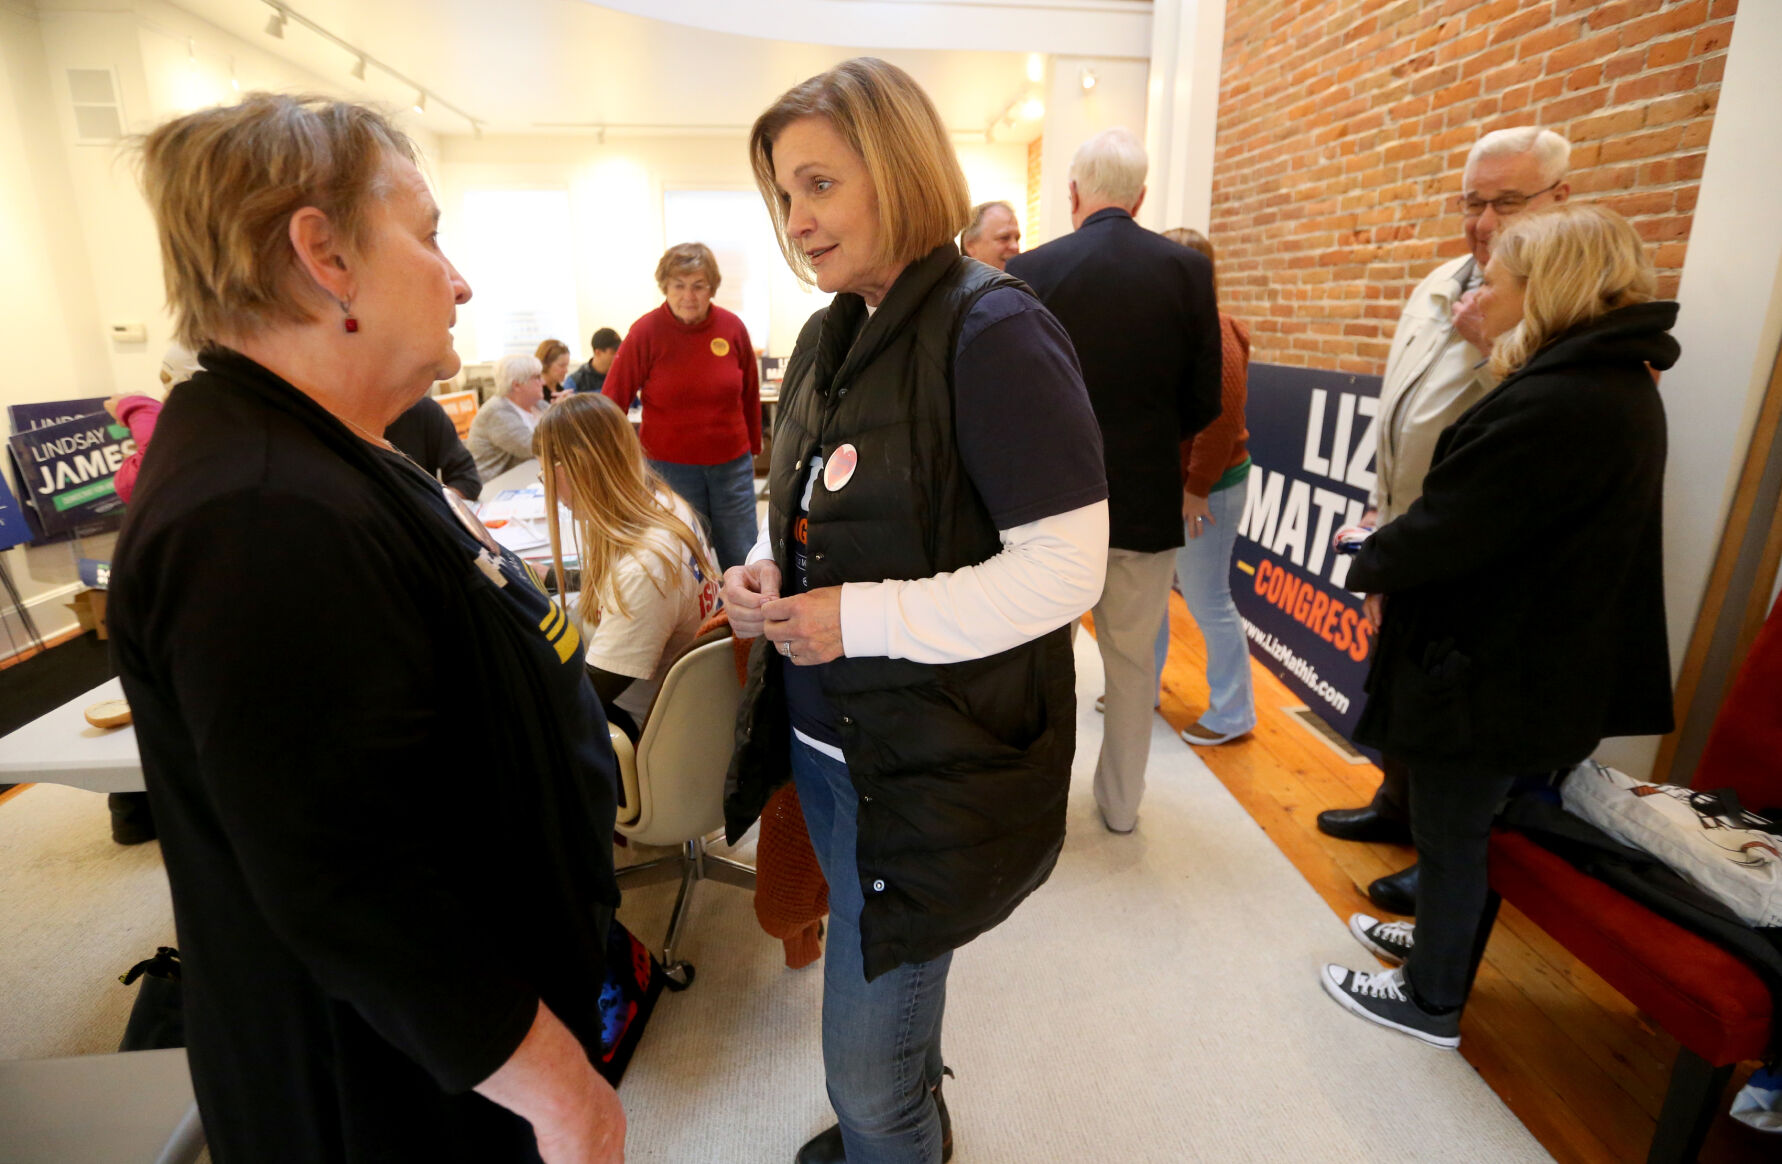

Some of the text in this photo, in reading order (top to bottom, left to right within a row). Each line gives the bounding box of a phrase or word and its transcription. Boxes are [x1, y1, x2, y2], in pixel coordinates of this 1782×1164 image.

[31, 427, 105, 462] LINDSAY
[1303, 388, 1380, 491] LIZ
[1254, 558, 1373, 662] CONGRESS
[1241, 616, 1350, 715] www.LizMathis.com
